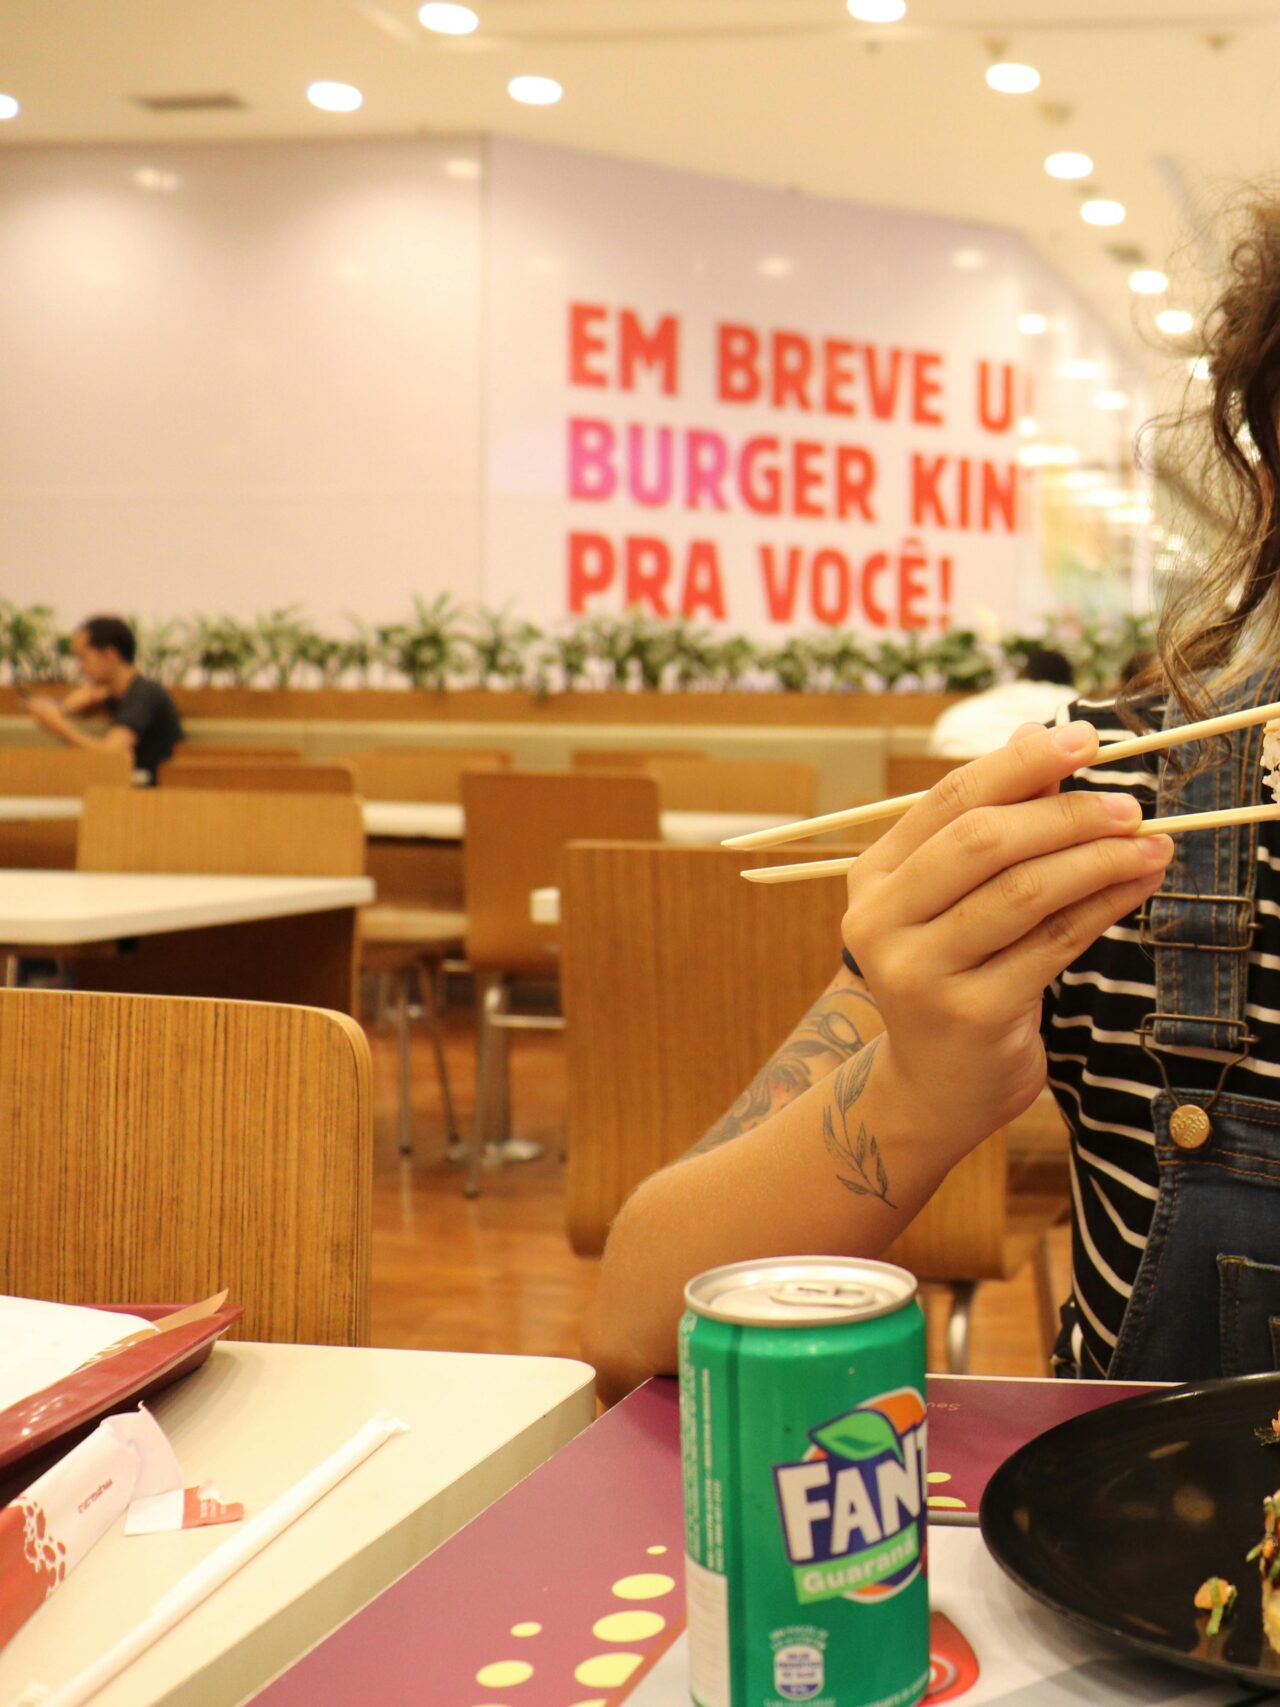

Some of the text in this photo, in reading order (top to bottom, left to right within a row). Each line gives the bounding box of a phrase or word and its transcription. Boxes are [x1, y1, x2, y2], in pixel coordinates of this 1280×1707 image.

[567, 303, 680, 397] EM
[716, 321, 944, 427] BREVE
[567, 416, 876, 522] BURGER
[567, 531, 954, 630] PRA VOCÊ!
[802, 1530, 915, 1595] Guaraná
